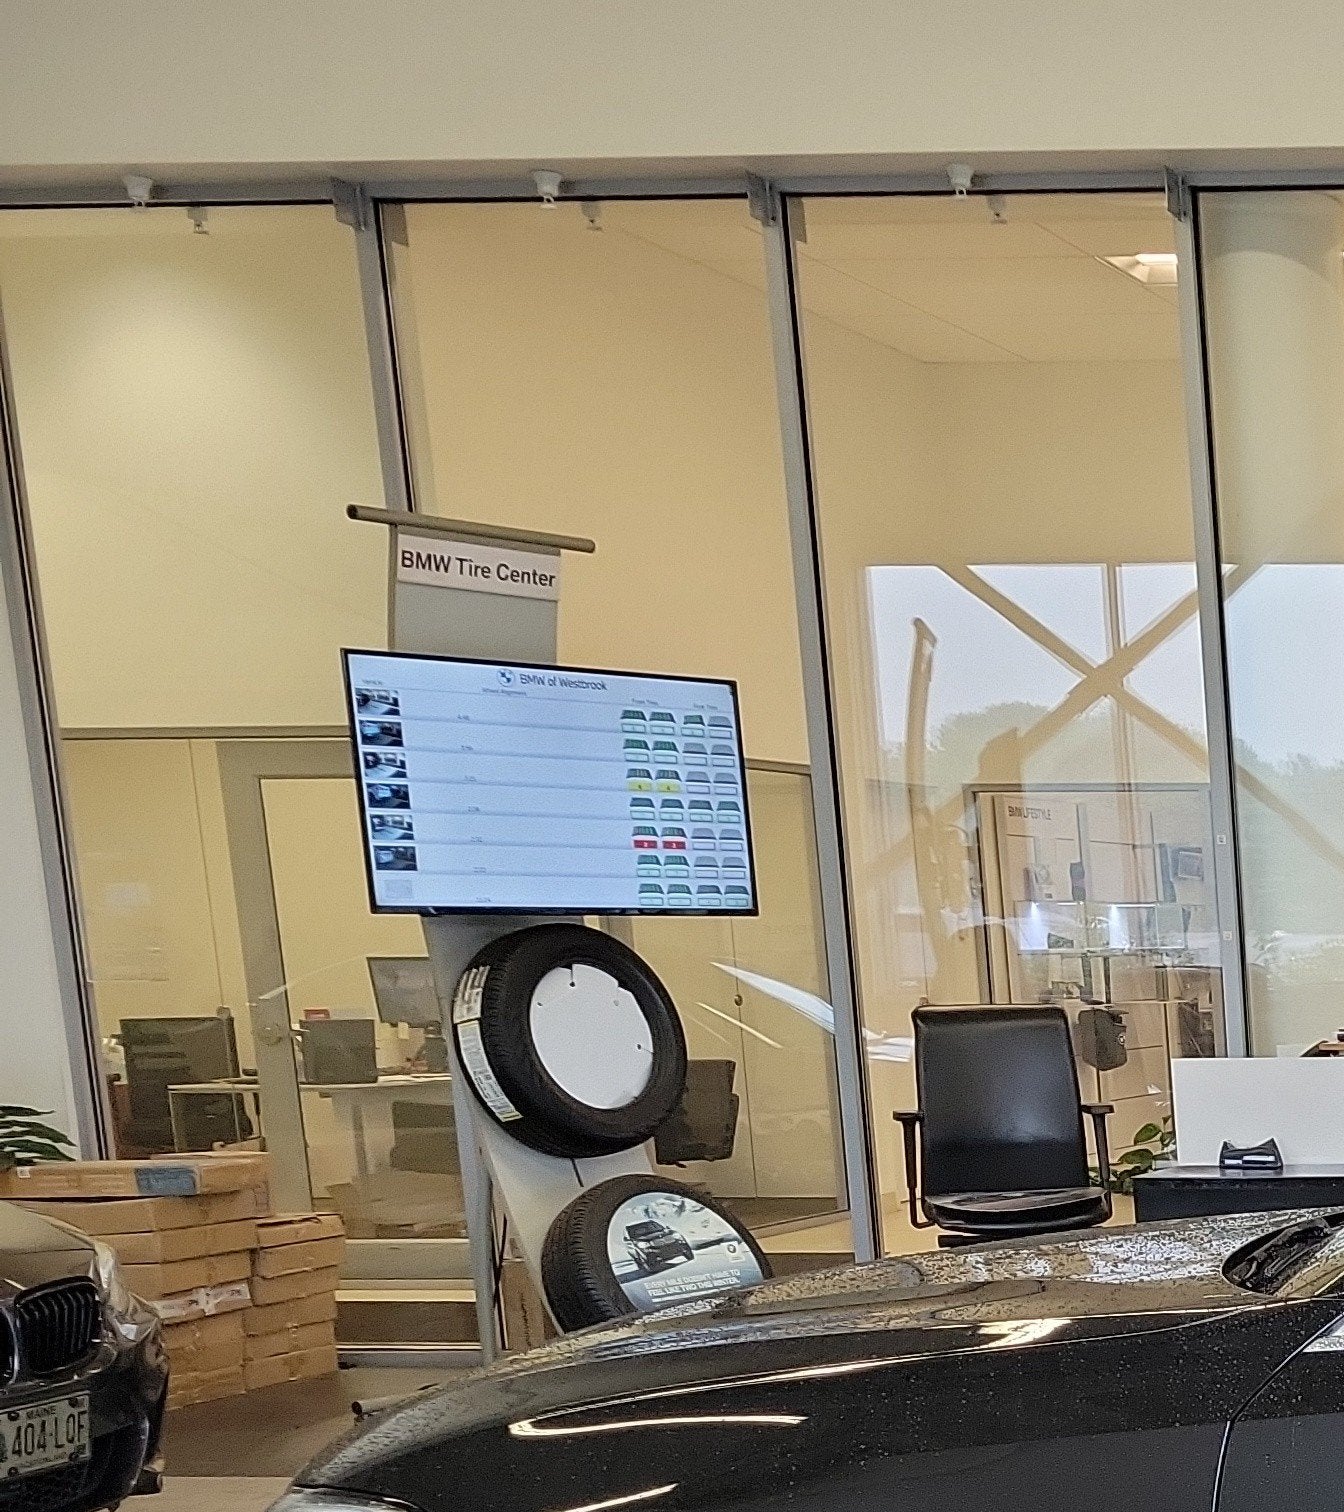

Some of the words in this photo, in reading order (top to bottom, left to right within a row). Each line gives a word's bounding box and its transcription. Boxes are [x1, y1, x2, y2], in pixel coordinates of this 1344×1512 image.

[401, 549, 452, 574] BMW
[455, 556, 491, 579] Tire
[496, 563, 556, 587] Center
[519, 673, 546, 686] BMW
[548, 676, 557, 687] of
[559, 677, 608, 690] Westbrook
